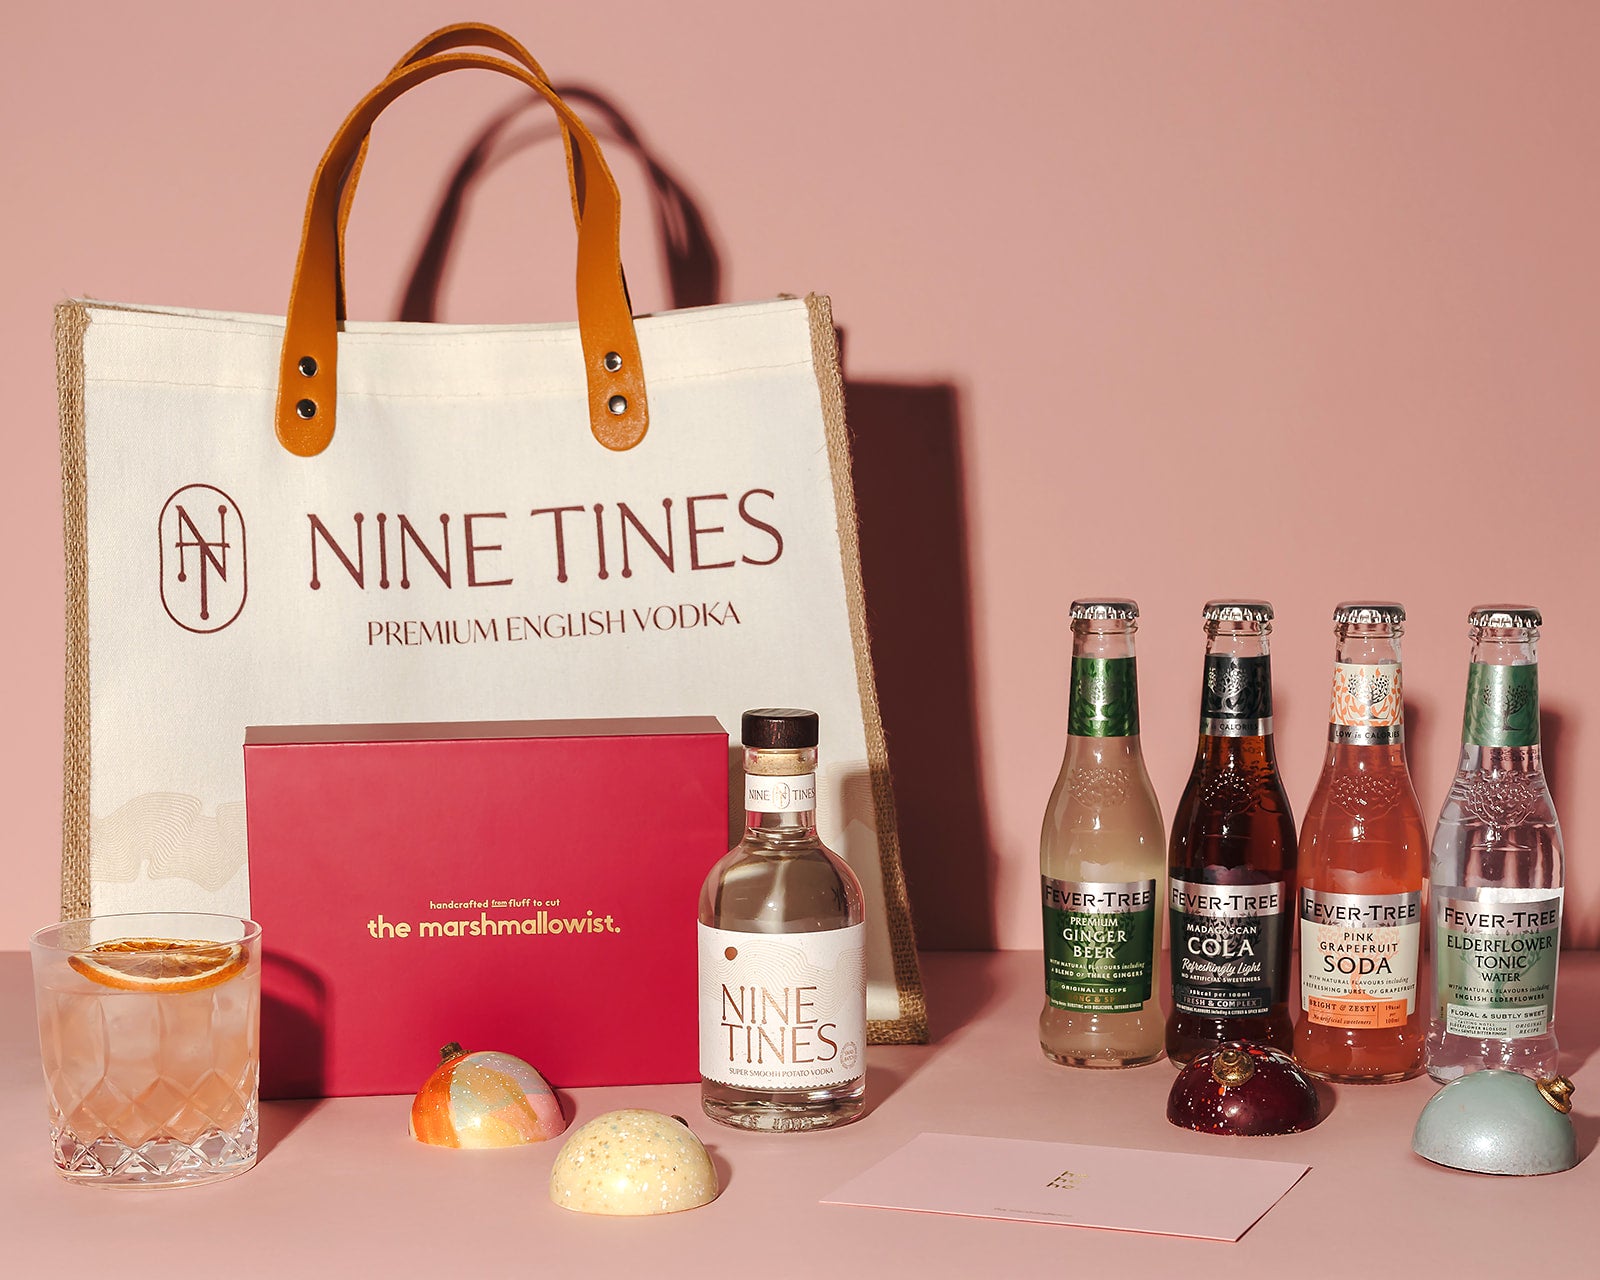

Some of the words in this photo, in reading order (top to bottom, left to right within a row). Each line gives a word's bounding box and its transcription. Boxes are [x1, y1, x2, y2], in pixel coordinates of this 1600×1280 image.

[307, 511, 513, 590] NINE
[530, 488, 785, 584] TINES
[368, 618, 499, 646] PREMIUM
[507, 609, 626, 642] ENGLISH
[632, 601, 741, 632] VODKA
[1335, 730, 1352, 738] LOW
[1364, 731, 1400, 739] CALORIES
[749, 788, 770, 801] NINE
[792, 786, 816, 801] TINES
[1045, 885, 1151, 907] FEVER-TREE
[1172, 887, 1278, 911] FEVER-TREE
[429, 899, 489, 910] handcrafted
[491, 899, 508, 907] from
[508, 898, 531, 908] fluff
[533, 899, 543, 907] to
[545, 898, 560, 907] cut
[1305, 898, 1416, 921] FEVER-TREE
[367, 914, 412, 939] the
[419, 910, 621, 937] marshmallowist.
[1070, 916, 1118, 927] PREMIUM
[1444, 907, 1556, 929] FEVER-TREE
[1186, 923, 1257, 934] MADAGASCAN
[1062, 929, 1128, 943] GINGER
[1344, 932, 1374, 942] PINK
[1187, 936, 1255, 957] COLA
[1319, 941, 1399, 953] GRAPEFRUIT
[1447, 935, 1553, 953] ELDERFLOWER
[1073, 946, 1116, 959] BEER
[1061, 961, 1087, 970] NATURAL
[1181, 957, 1237, 977] Refreshingly
[1236, 961, 1261, 976] Light
[1323, 955, 1393, 975] SODA
[1475, 955, 1528, 969] TONIC
[1055, 968, 1074, 977] BLEND
[1113, 970, 1143, 979] GINGERS
[1190, 974, 1221, 982] ARTIFICIAL
[1221, 975, 1261, 983] SWEETENERS
[1481, 972, 1521, 982] WATER
[1321, 977, 1349, 985] NATURAL
[1385, 976, 1409, 985] including
[1061, 984, 1096, 993] ORIGINAL
[1306, 982, 1341, 993] REFRESHING
[1343, 987, 1367, 995] BURST
[1379, 983, 1416, 994] GRAPEFRUIT
[1448, 983, 1463, 991] WITH
[1464, 985, 1493, 994] NATURAL
[1529, 983, 1550, 993] including
[721, 983, 819, 1025] NINE
[1183, 996, 1205, 1006] FRESH
[1208, 999, 1215, 1007] &
[1216, 998, 1258, 1008] COMPLEX
[1455, 993, 1487, 1002] ENGLISH
[1490, 994, 1545, 1003] ELDERFLOWERS
[1309, 999, 1338, 1011] BRIGHT
[1338, 1003, 1346, 1011] &
[1348, 1003, 1377, 1012] ZESTY
[1450, 1009, 1479, 1019] FLORAL
[1490, 1011, 1522, 1020] SUBTLY
[1524, 1009, 1545, 1018] SWEET
[1515, 1021, 1542, 1029] ORIGINAL
[720, 1022, 838, 1065] TINES
[729, 1067, 749, 1076] SUPER
[749, 1069, 781, 1078] SMOOTH
[782, 1069, 810, 1078] POTATO
[811, 1066, 835, 1076] VODKA
